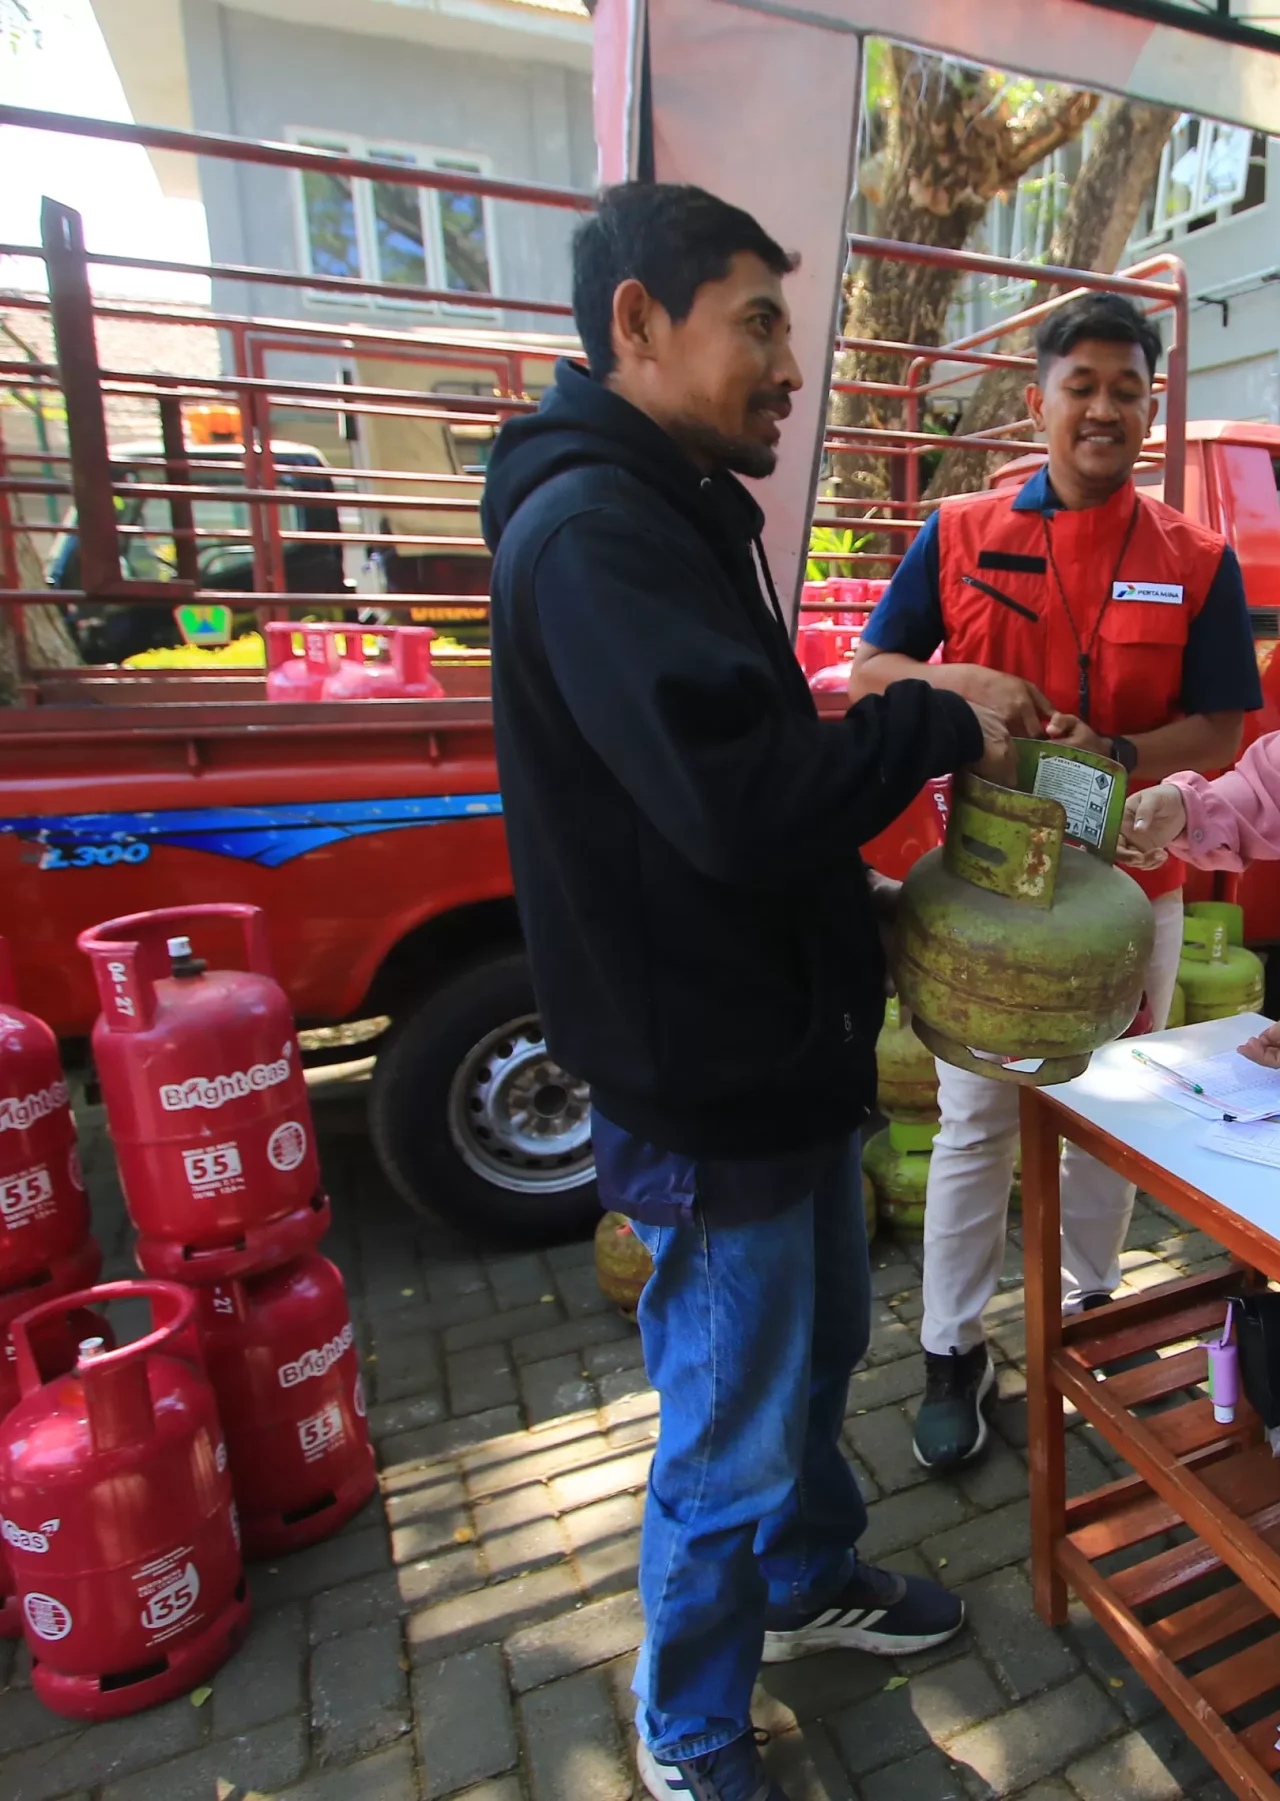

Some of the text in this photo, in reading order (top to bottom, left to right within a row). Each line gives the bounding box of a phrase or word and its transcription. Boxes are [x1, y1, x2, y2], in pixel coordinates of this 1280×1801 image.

[1136, 588, 1180, 600] PERTAMINA
[39, 842, 151, 870] L300
[162, 1060, 291, 1109] Bright Gas
[279, 1336, 343, 1387] Bright
[4, 1521, 48, 1551] Gas
[144, 1584, 193, 1626] 135
